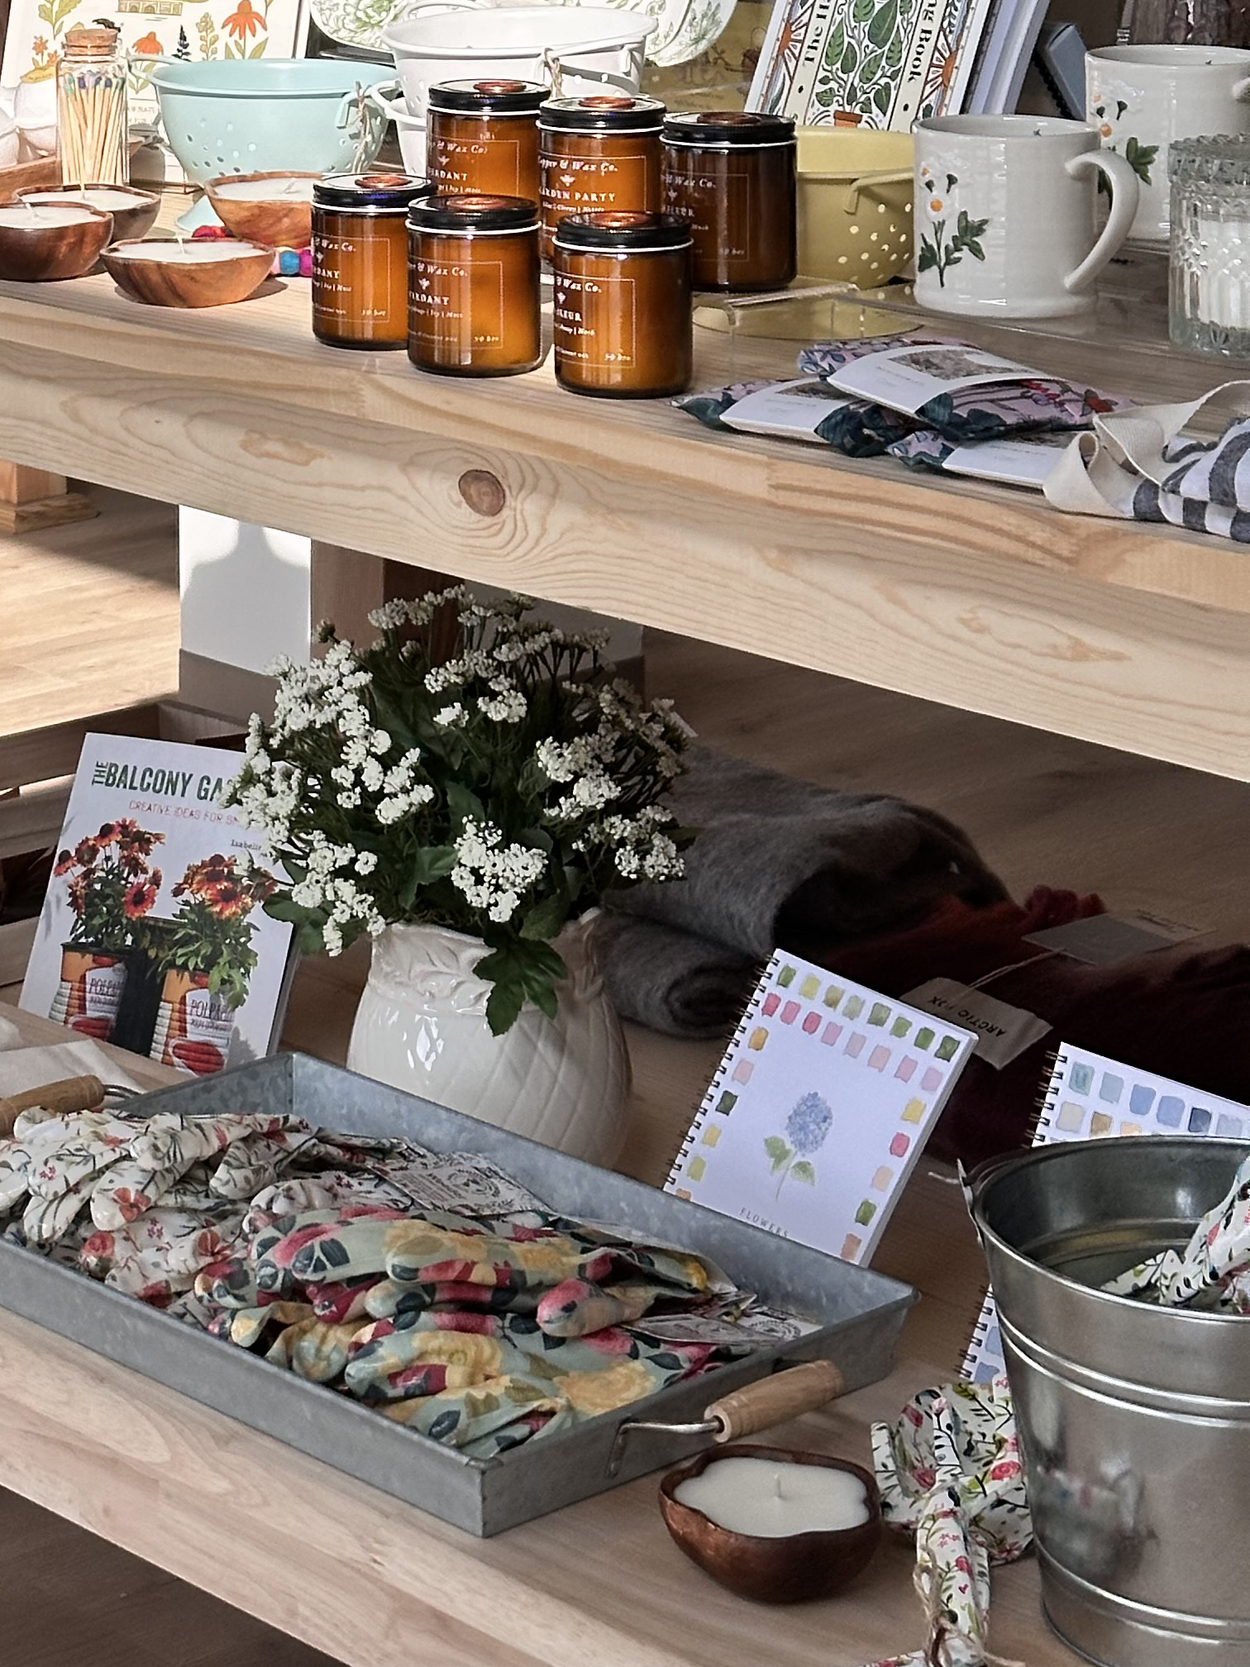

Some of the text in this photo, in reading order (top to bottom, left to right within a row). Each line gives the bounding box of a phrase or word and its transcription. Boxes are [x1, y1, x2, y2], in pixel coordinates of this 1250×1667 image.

[803, 27, 824, 68] The
[907, 28, 933, 83] Book
[446, 142, 468, 154] Wax
[572, 161, 597, 172] Wax
[538, 186, 616, 203] ARDEN PARTY
[427, 264, 448, 276] Wax
[562, 278, 582, 291] Wax
[584, 282, 602, 294] Co.
[91, 761, 109, 786] THE
[104, 762, 194, 798] BALCONY
[129, 799, 170, 816] CREATIVE
[174, 808, 201, 820] IDEAS
[204, 810, 224, 824] FOR
[957, 1008, 1006, 1037] ARCTIC
[739, 1206, 789, 1238] FLOWERS
